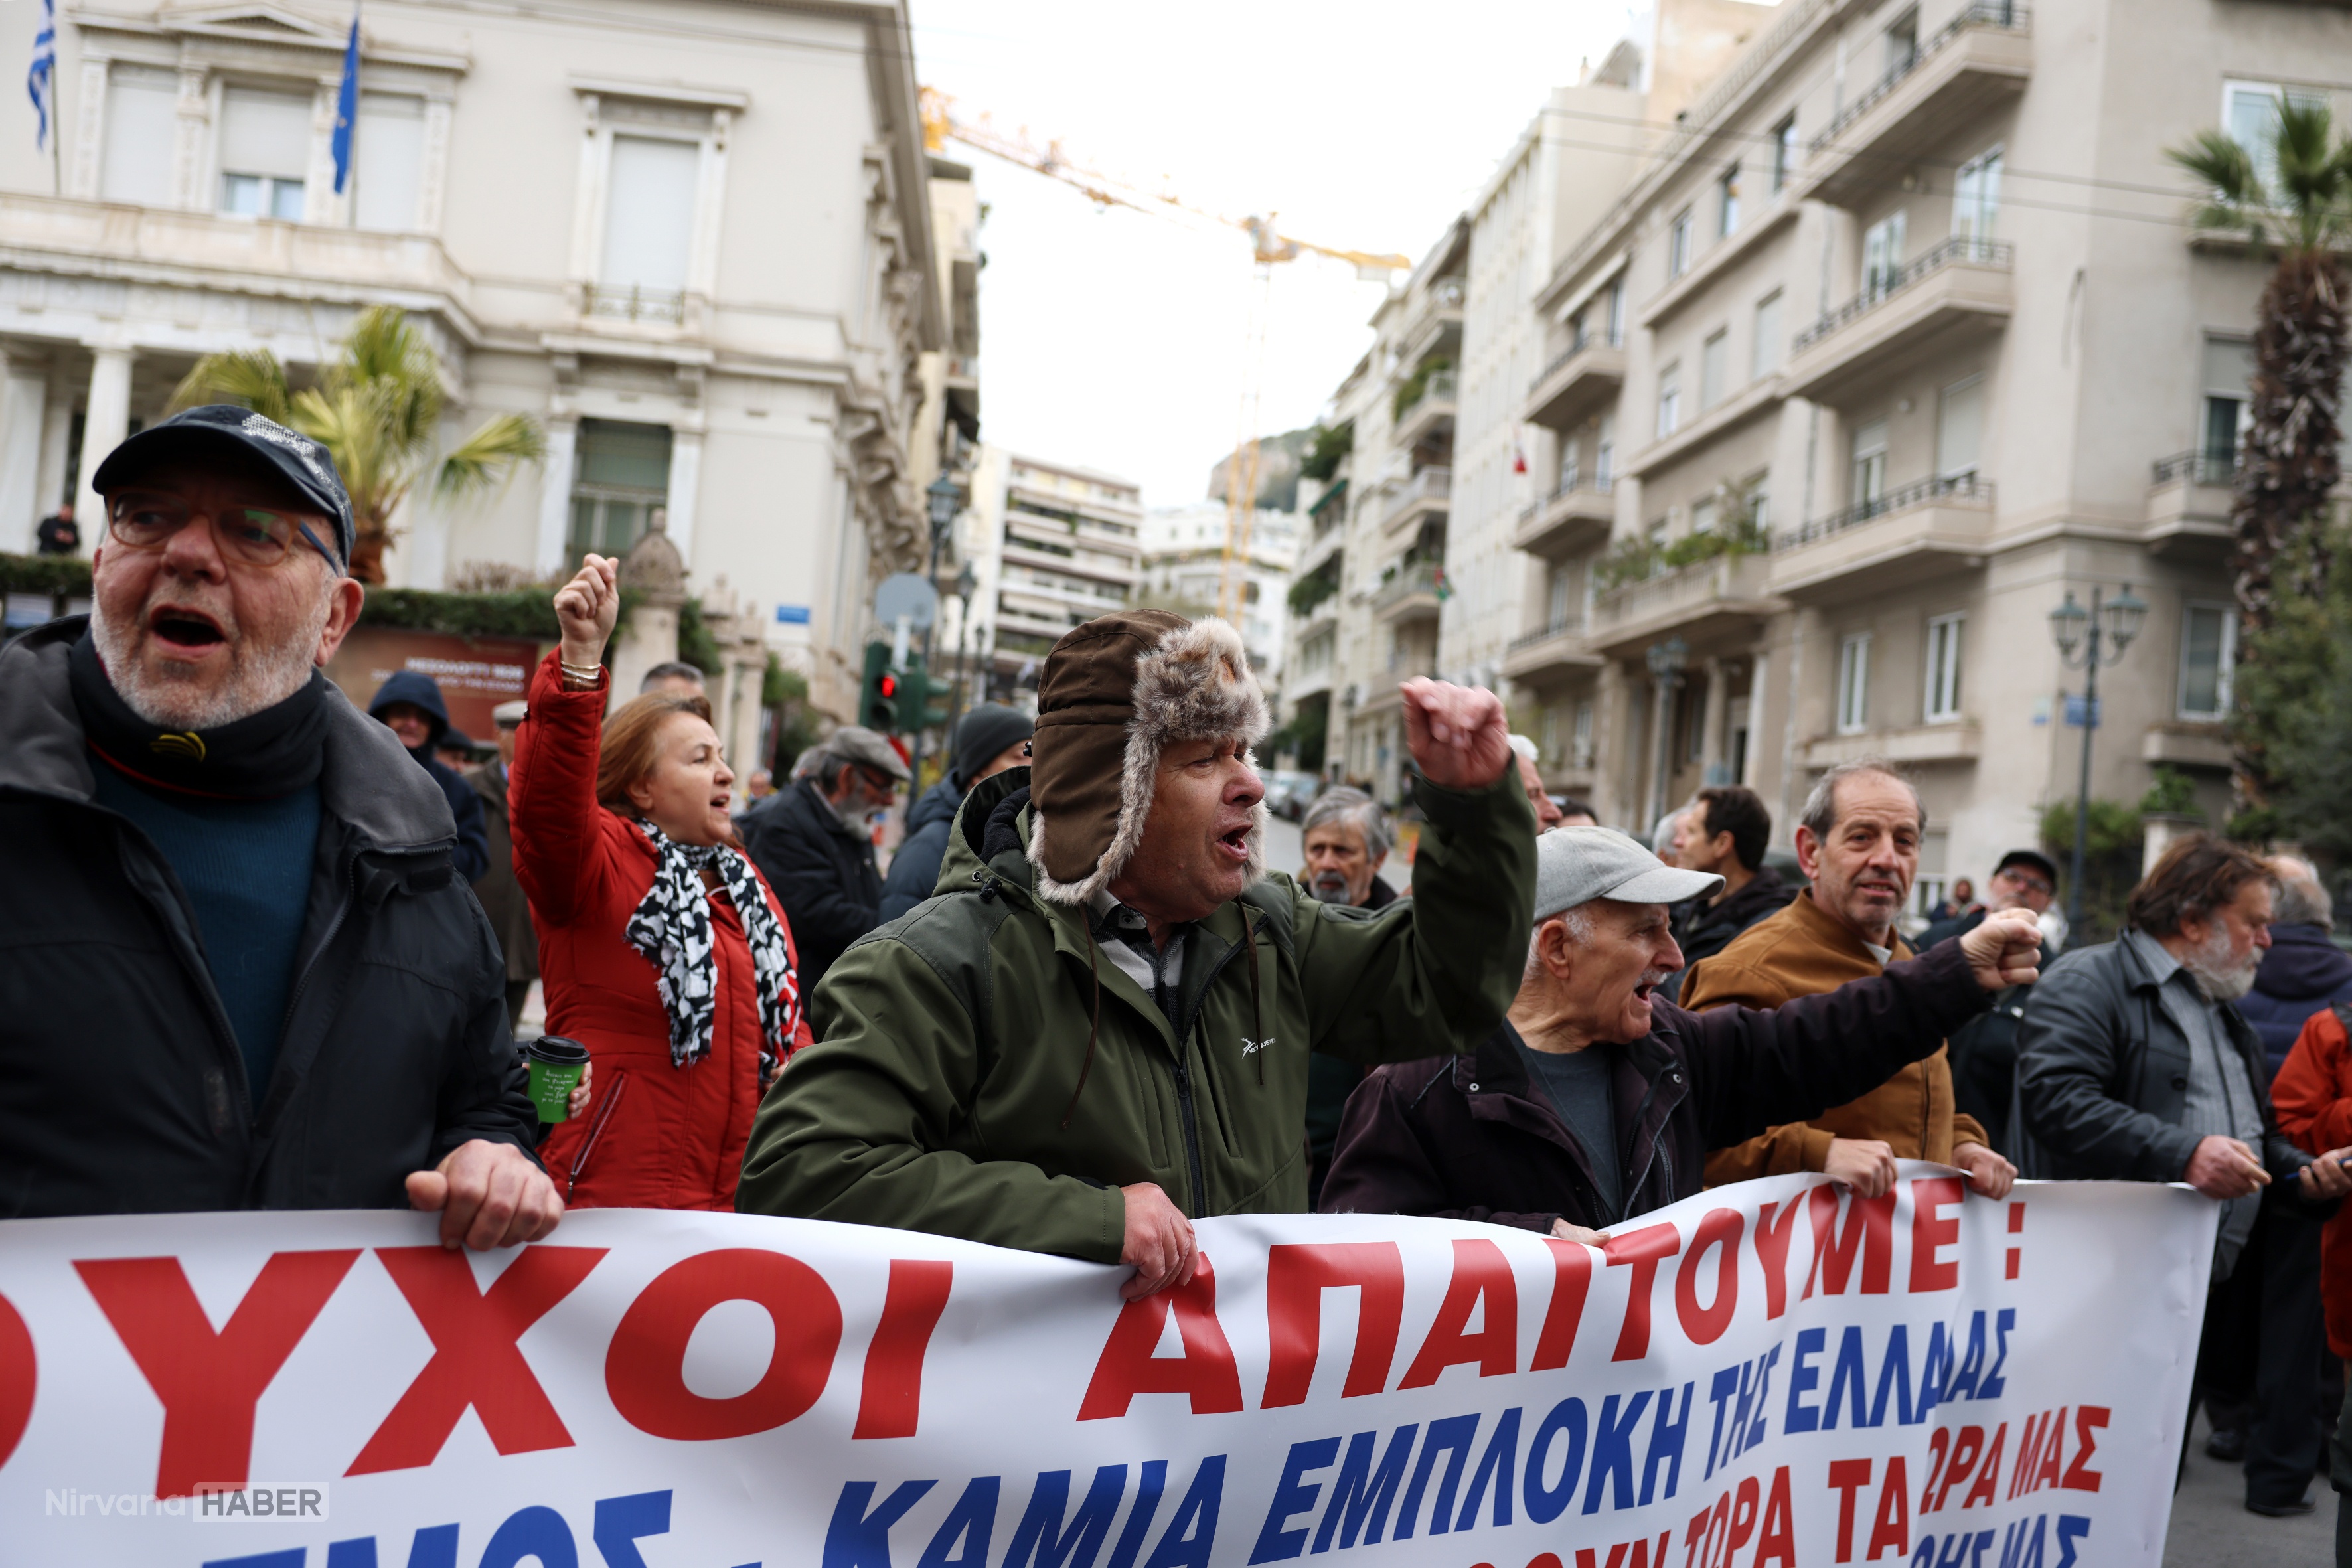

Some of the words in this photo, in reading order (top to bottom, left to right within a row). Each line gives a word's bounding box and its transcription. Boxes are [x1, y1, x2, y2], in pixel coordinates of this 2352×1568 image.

[0, 1246, 953, 1500] ΥΧΟΙ
[1077, 1179, 1962, 1421] ΑΠΑΙΤΟΥΜΕ
[822, 1455, 1227, 1568] ΚΑΜΙΑ
[1248, 1381, 1694, 1565] ΕΜΠΛΟΚΗ
[1703, 1342, 1782, 1482] ΤΗΣ
[1828, 1456, 1909, 1564] ΤΑ
[2007, 1405, 2110, 1500] ΜΑΣ
